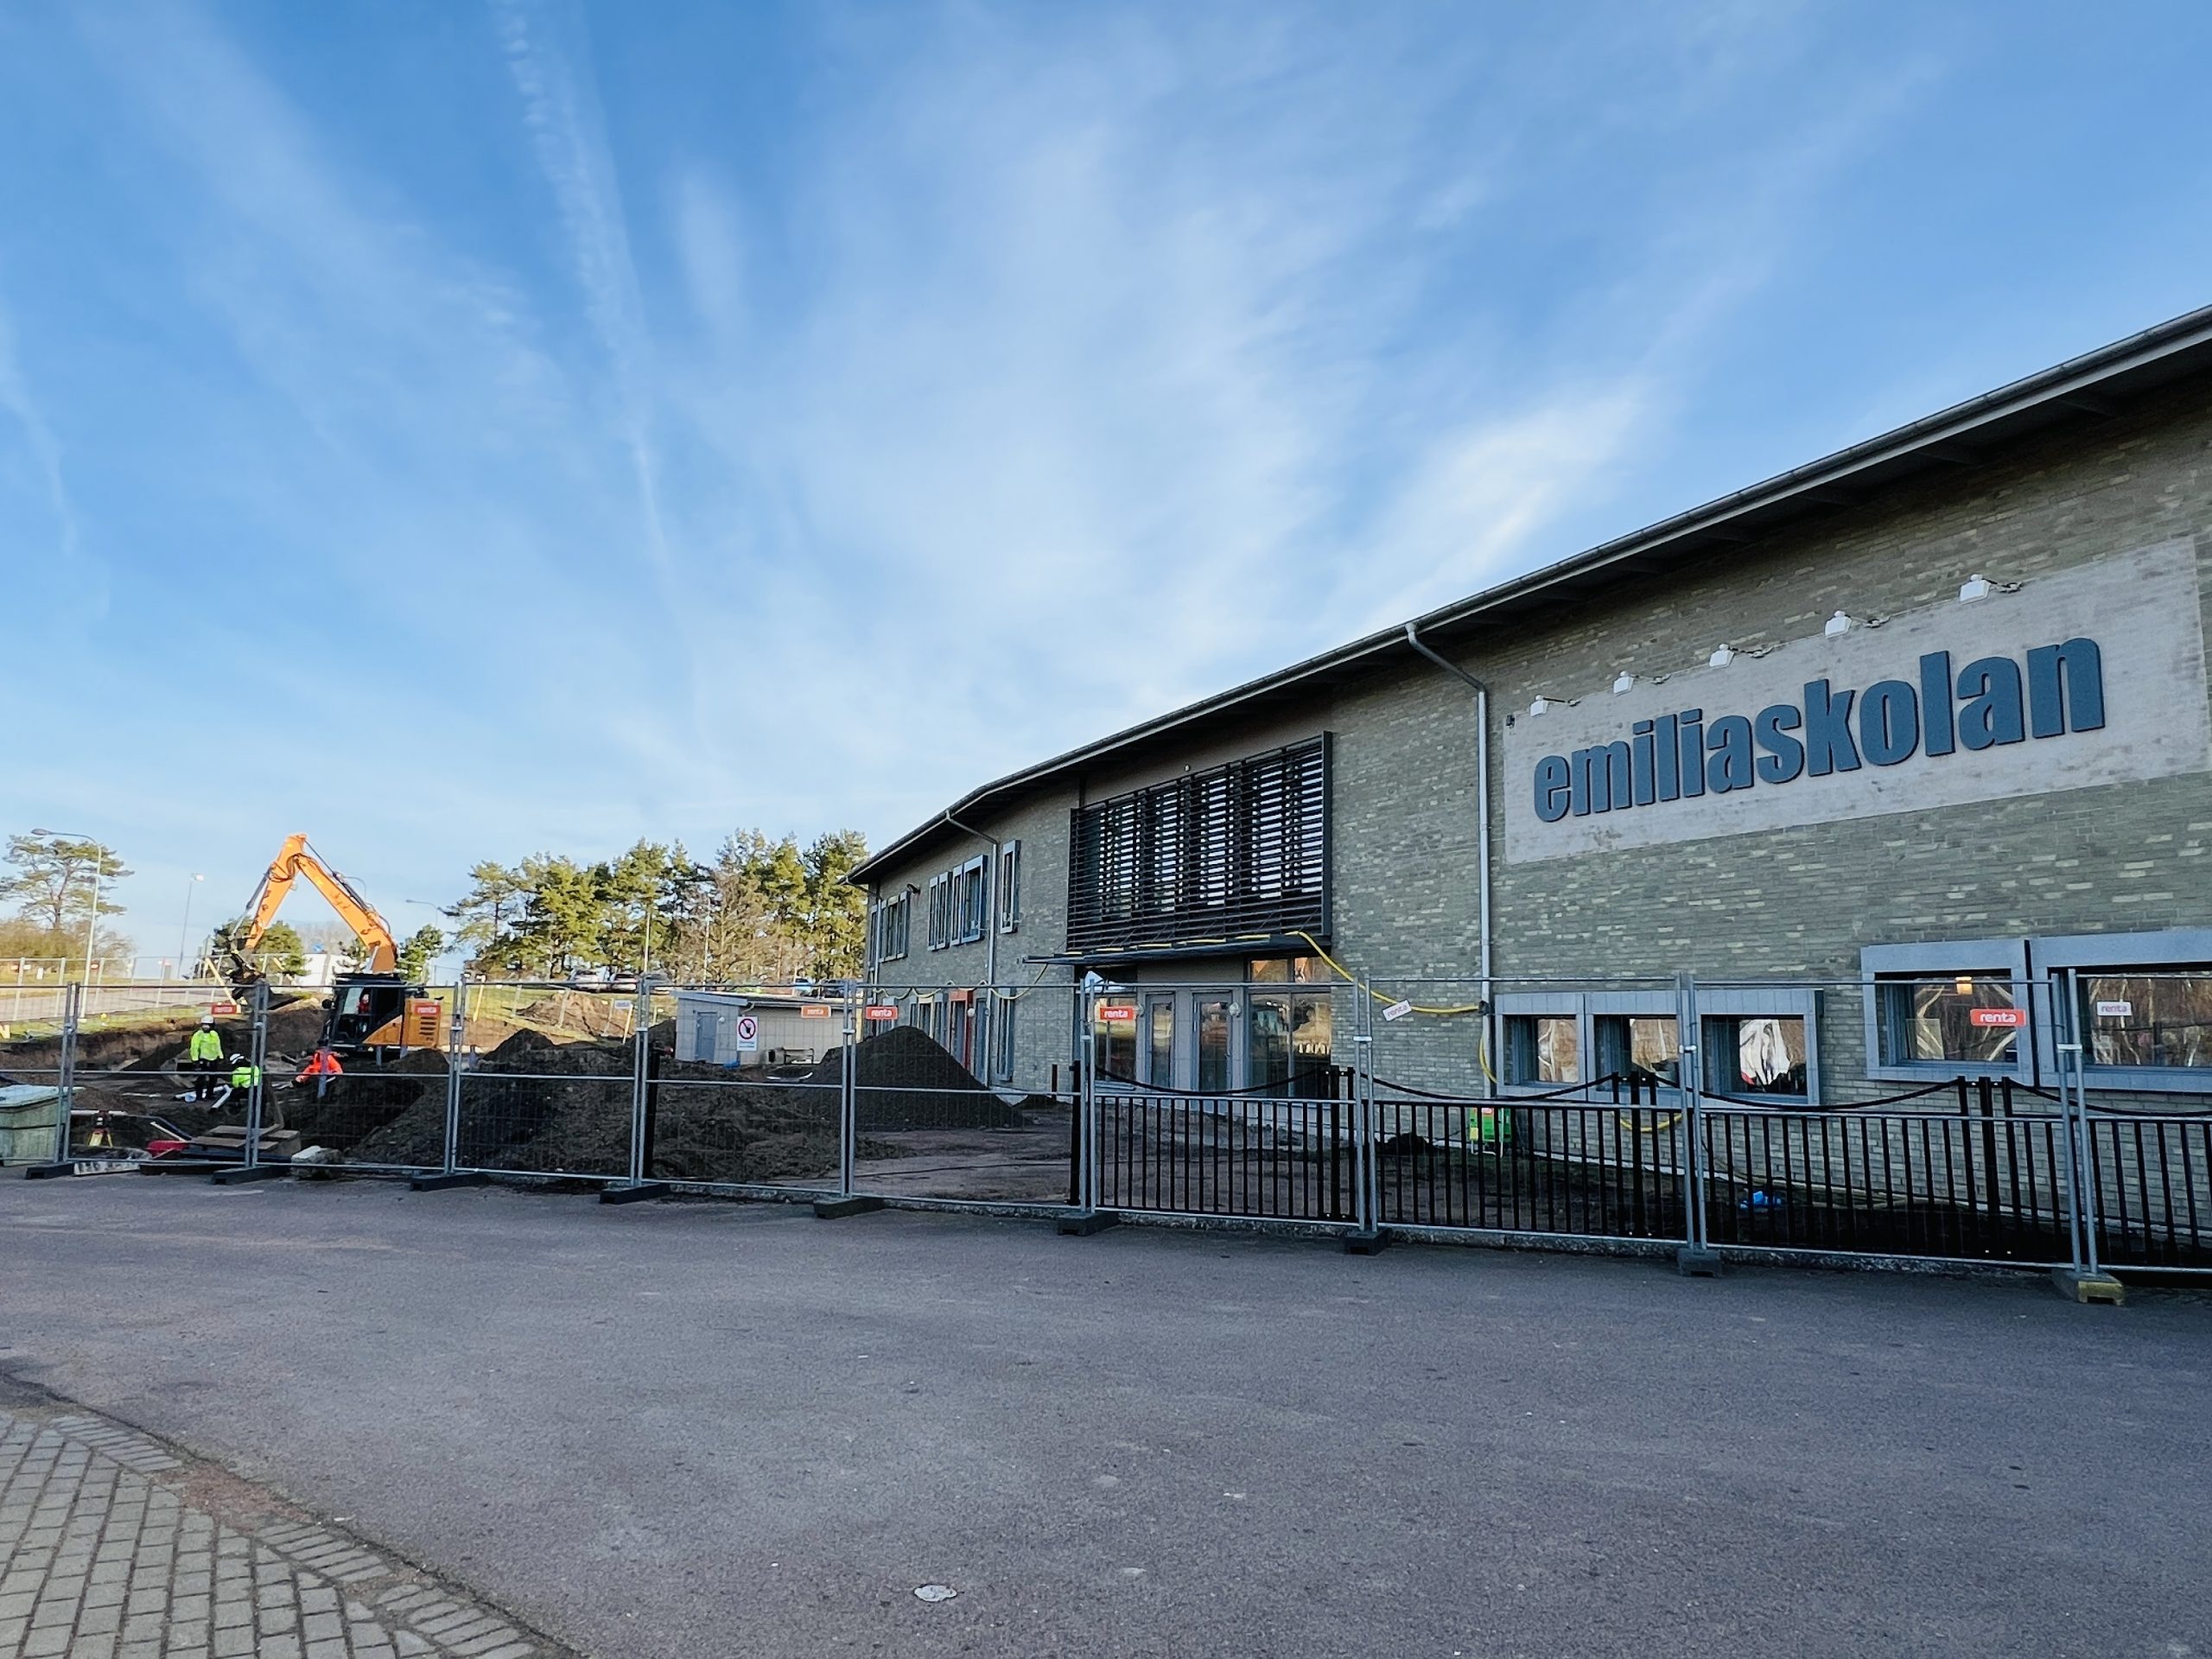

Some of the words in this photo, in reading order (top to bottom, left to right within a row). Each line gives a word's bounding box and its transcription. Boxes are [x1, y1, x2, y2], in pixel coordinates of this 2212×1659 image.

[1534, 638, 2105, 823] emiliaskolan
[1104, 1009, 1128, 1018] renta
[1387, 1005, 1408, 1016] renta
[1980, 1013, 2017, 1023] renta
